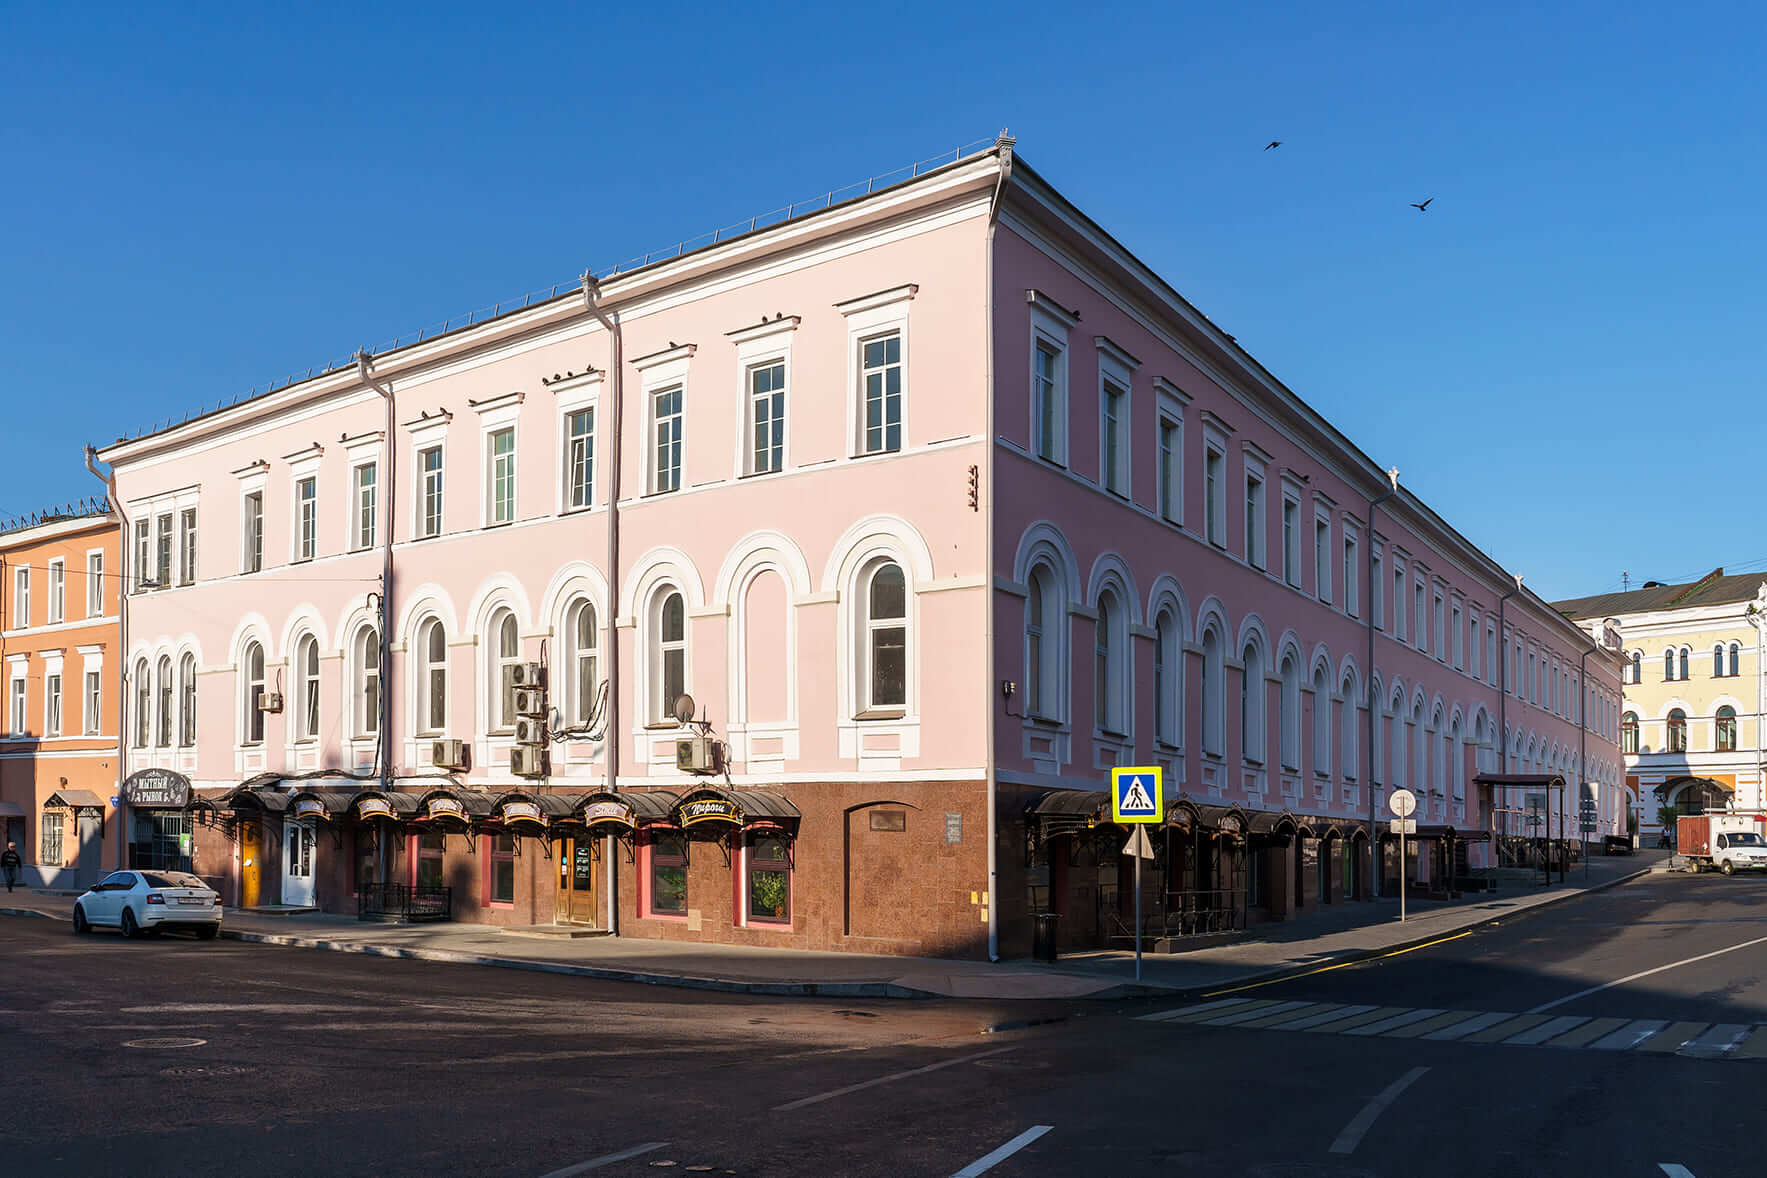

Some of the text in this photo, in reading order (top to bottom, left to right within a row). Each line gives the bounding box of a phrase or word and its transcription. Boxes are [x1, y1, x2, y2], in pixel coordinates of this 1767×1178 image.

[138, 776, 168, 789] МЫТНЫЙ
[142, 791, 163, 802] РЫНОК
[691, 802, 725, 815] Пироги
